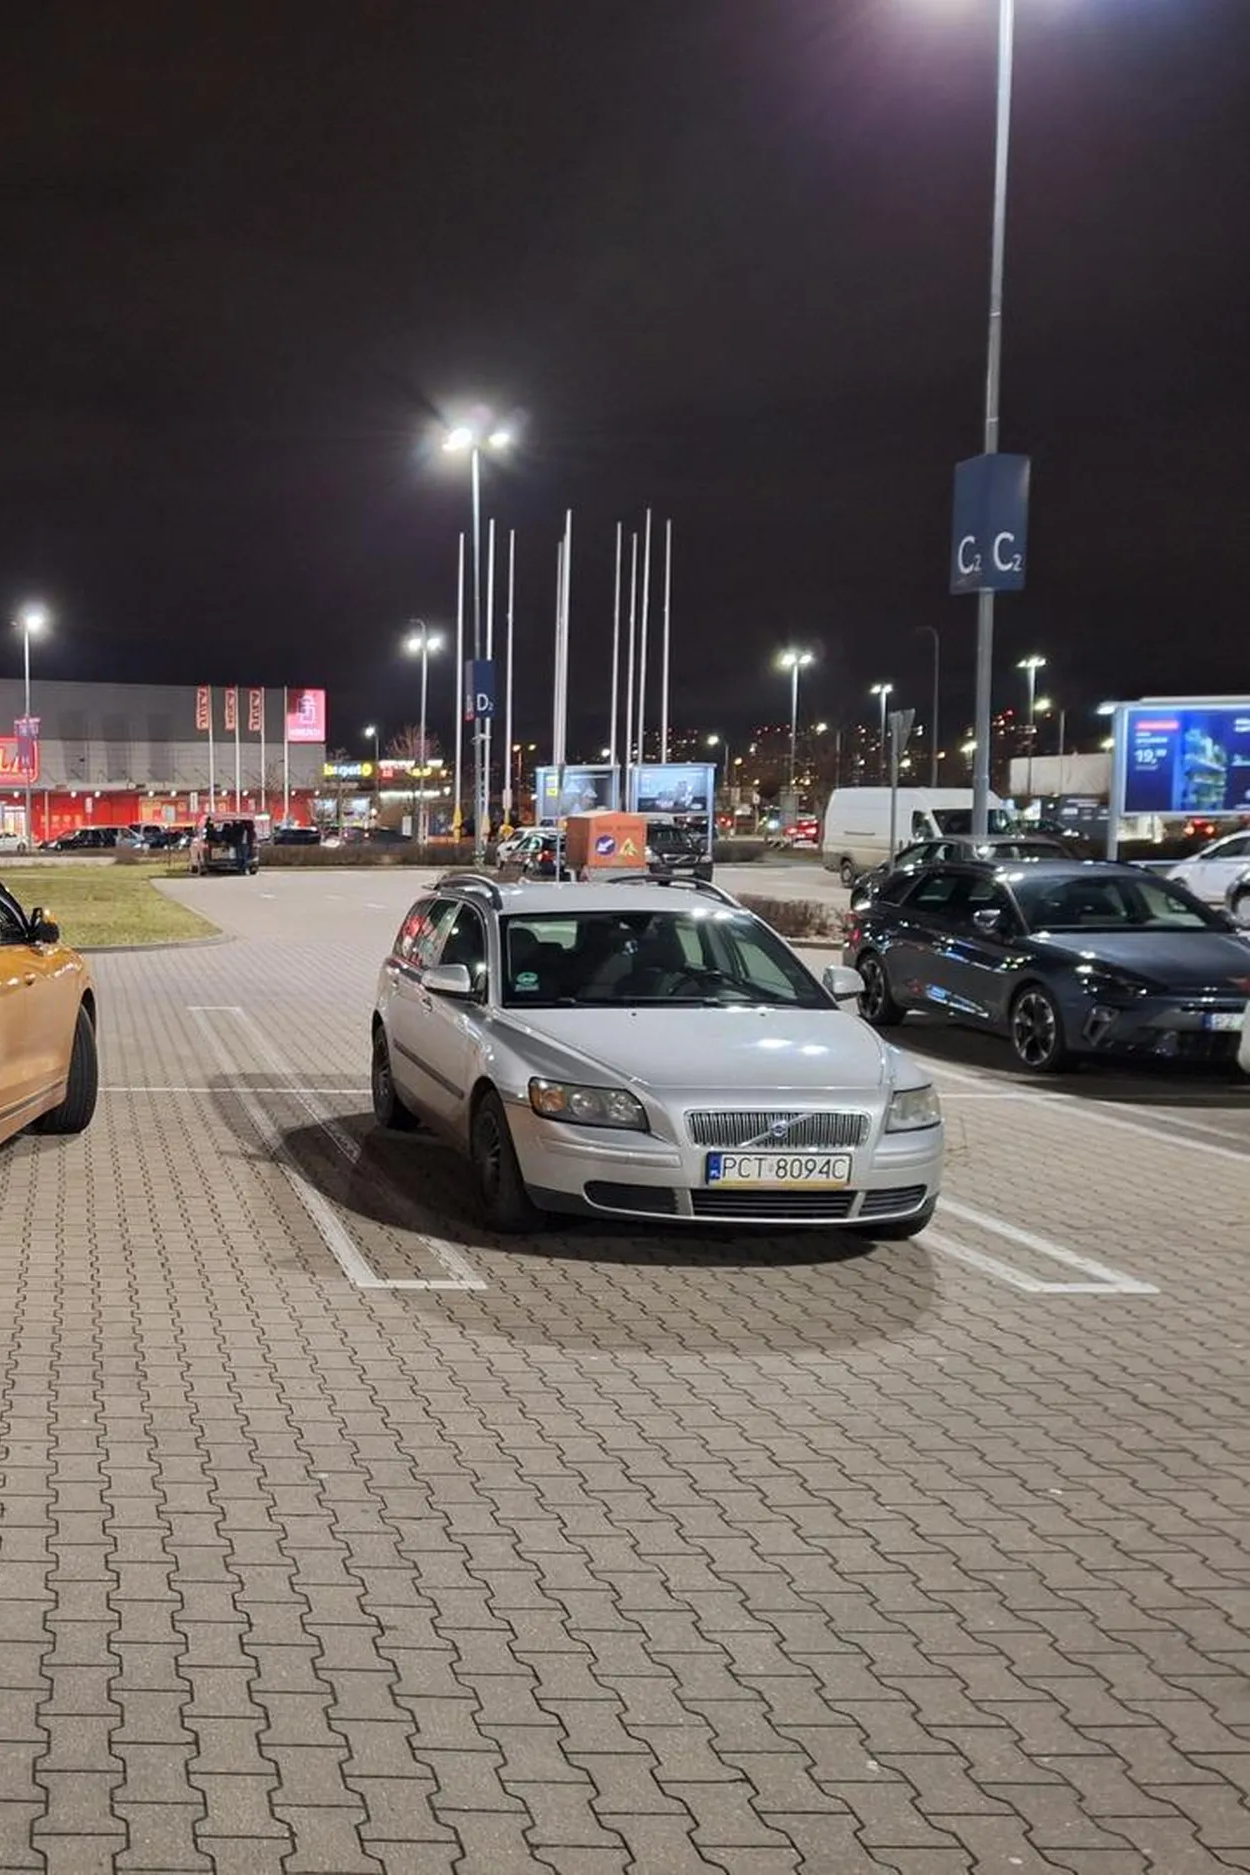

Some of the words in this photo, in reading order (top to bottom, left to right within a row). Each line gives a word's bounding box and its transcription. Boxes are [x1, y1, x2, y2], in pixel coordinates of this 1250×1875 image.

[957, 534, 982, 575] C2
[993, 531, 1023, 572] C2
[477, 693, 494, 711] D2
[722, 1157, 768, 1178] PCT
[775, 1157, 847, 1180] 8094C
